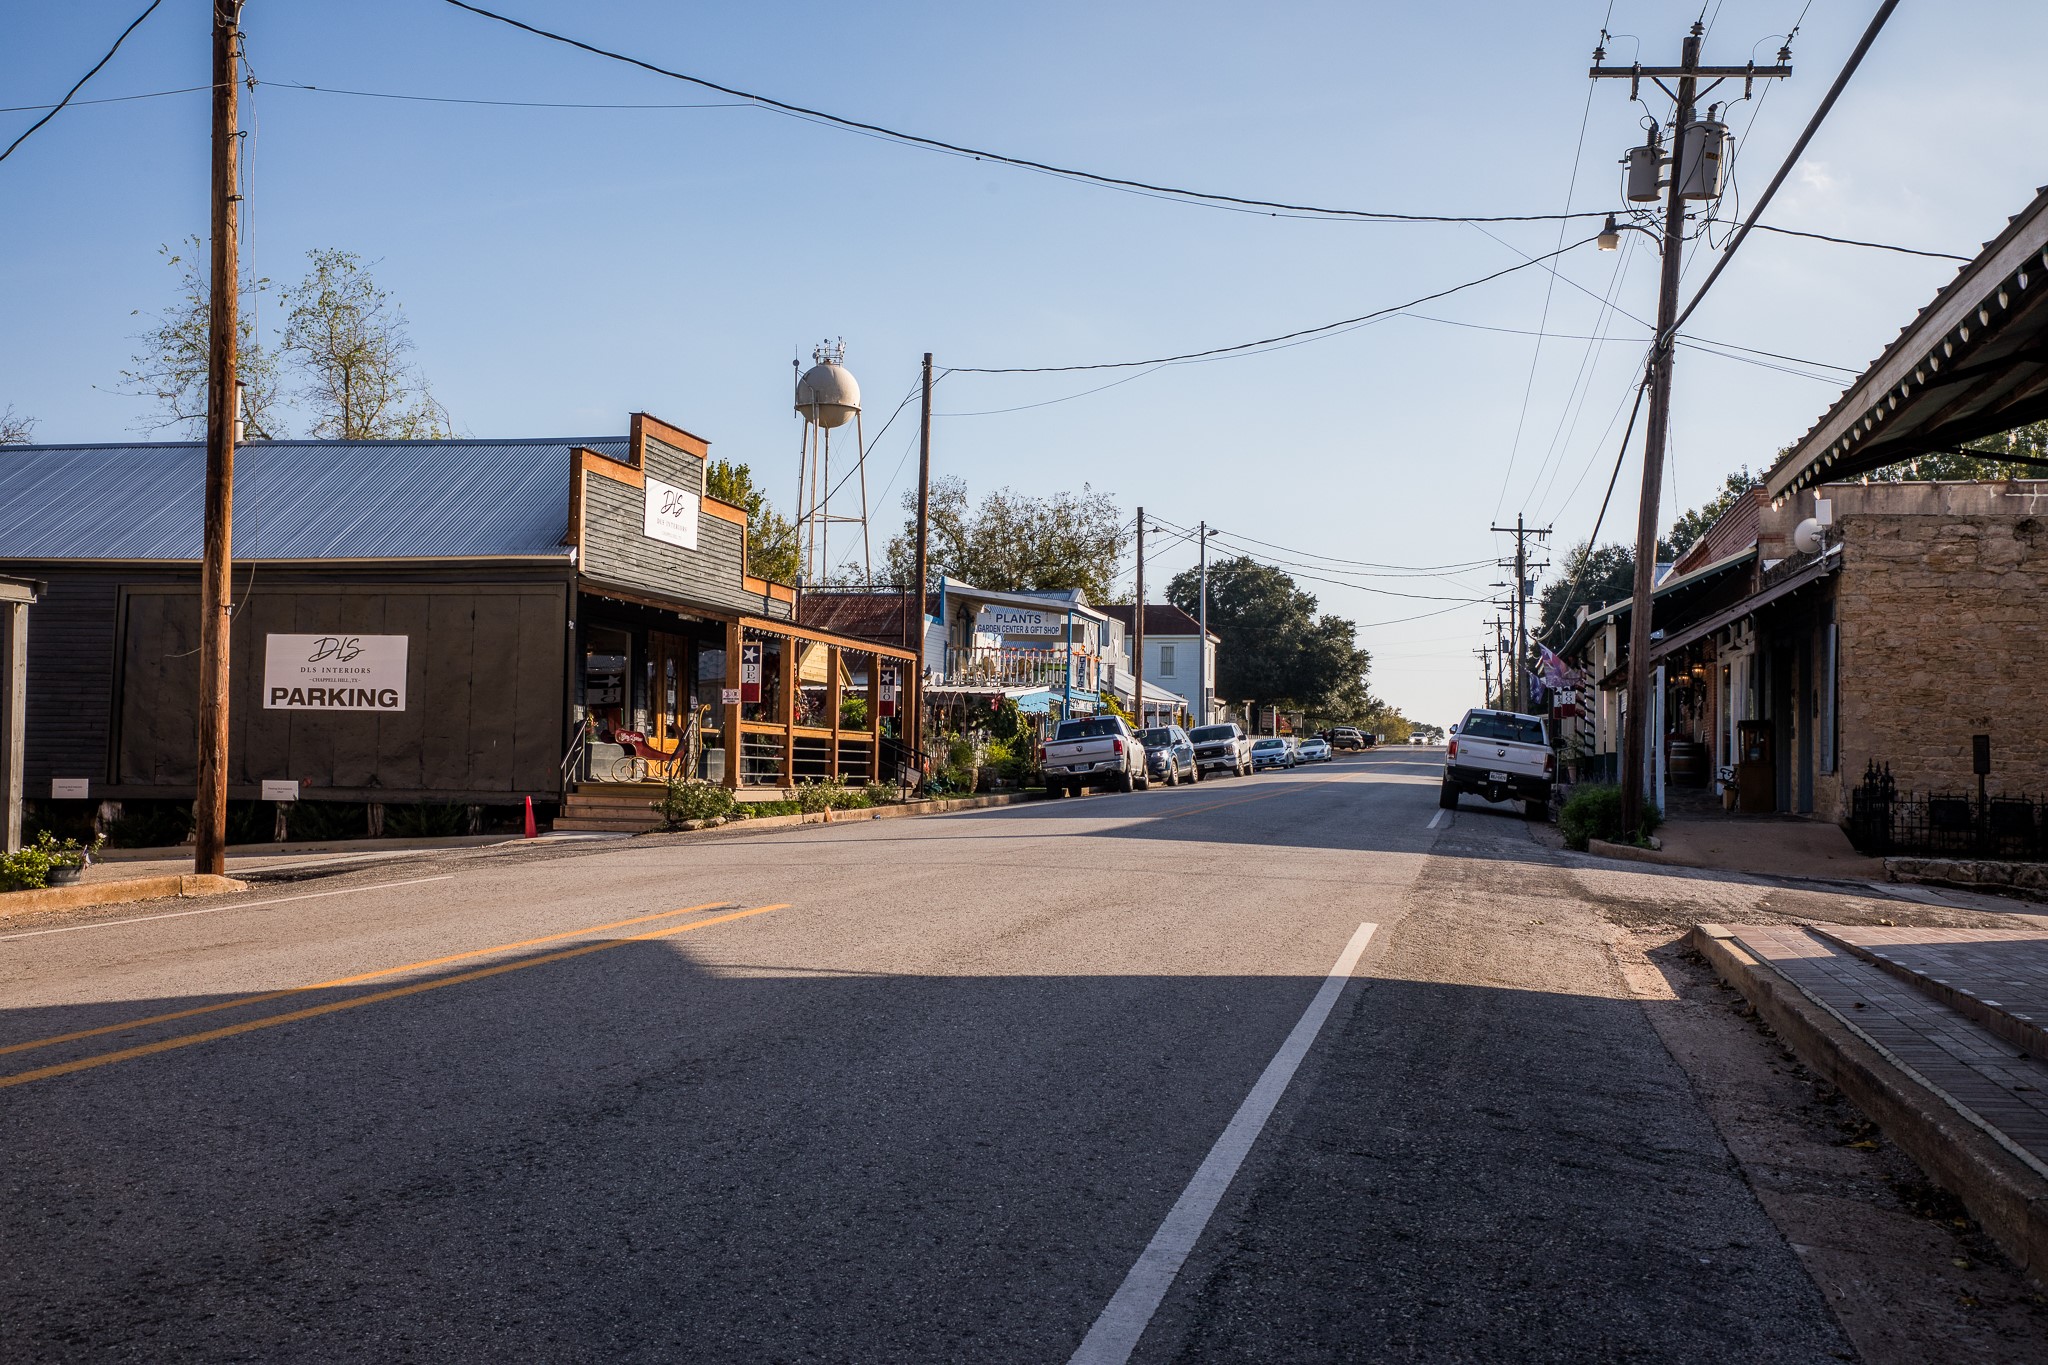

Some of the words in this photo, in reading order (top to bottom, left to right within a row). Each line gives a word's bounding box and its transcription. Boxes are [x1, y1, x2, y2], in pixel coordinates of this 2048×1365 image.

[995, 613, 1042, 624] PLANTS
[977, 624, 1000, 633] GARDEN
[1001, 625, 1024, 634] CENTER
[1024, 626, 1029, 634] &
[1030, 626, 1042, 634] GIFT
[1043, 626, 1060, 635] SHOP
[307, 636, 366, 663] DLS
[300, 666, 317, 674] DLS
[1077, 656, 1086, 688] GIFTS
[270, 687, 399, 708] PARKING
